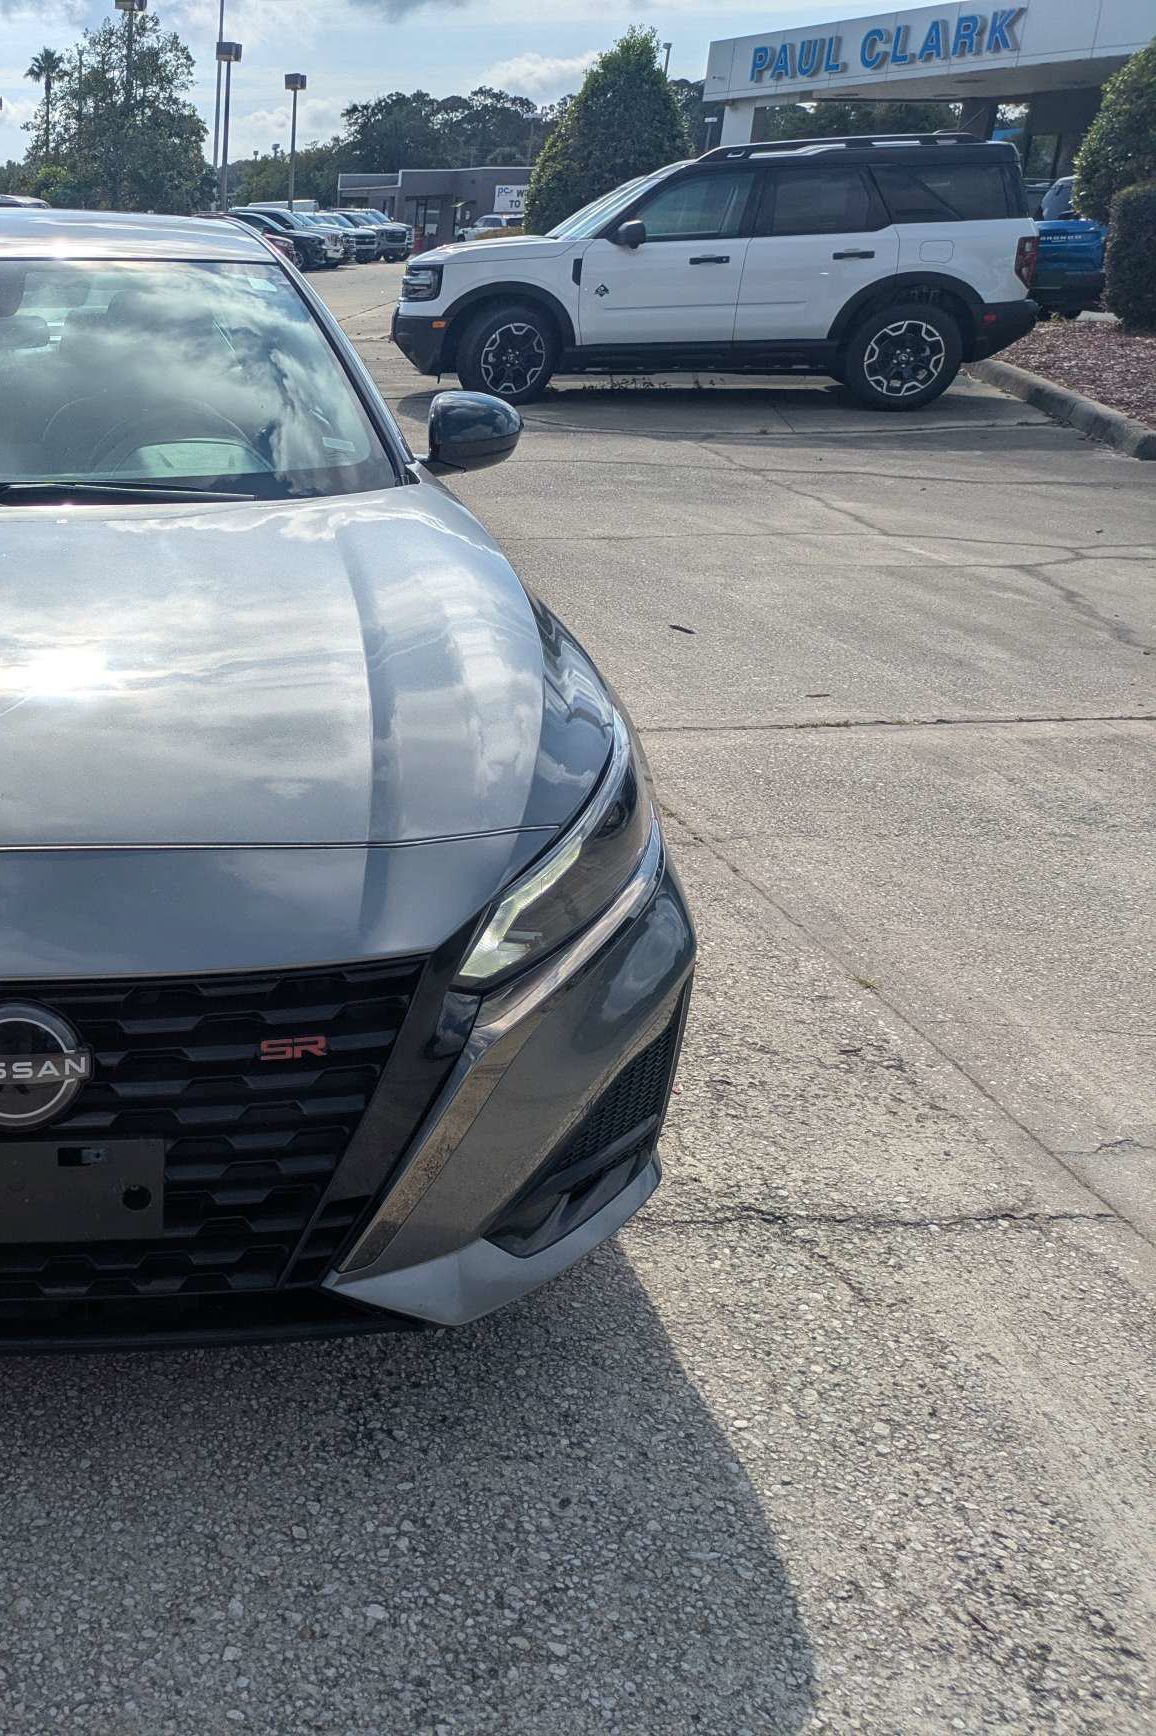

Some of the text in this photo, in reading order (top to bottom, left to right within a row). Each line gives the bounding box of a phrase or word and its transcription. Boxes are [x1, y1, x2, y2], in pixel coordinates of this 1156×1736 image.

[748, 8, 1020, 82] PAUL CLARK
[260, 1036, 327, 1061] SR
